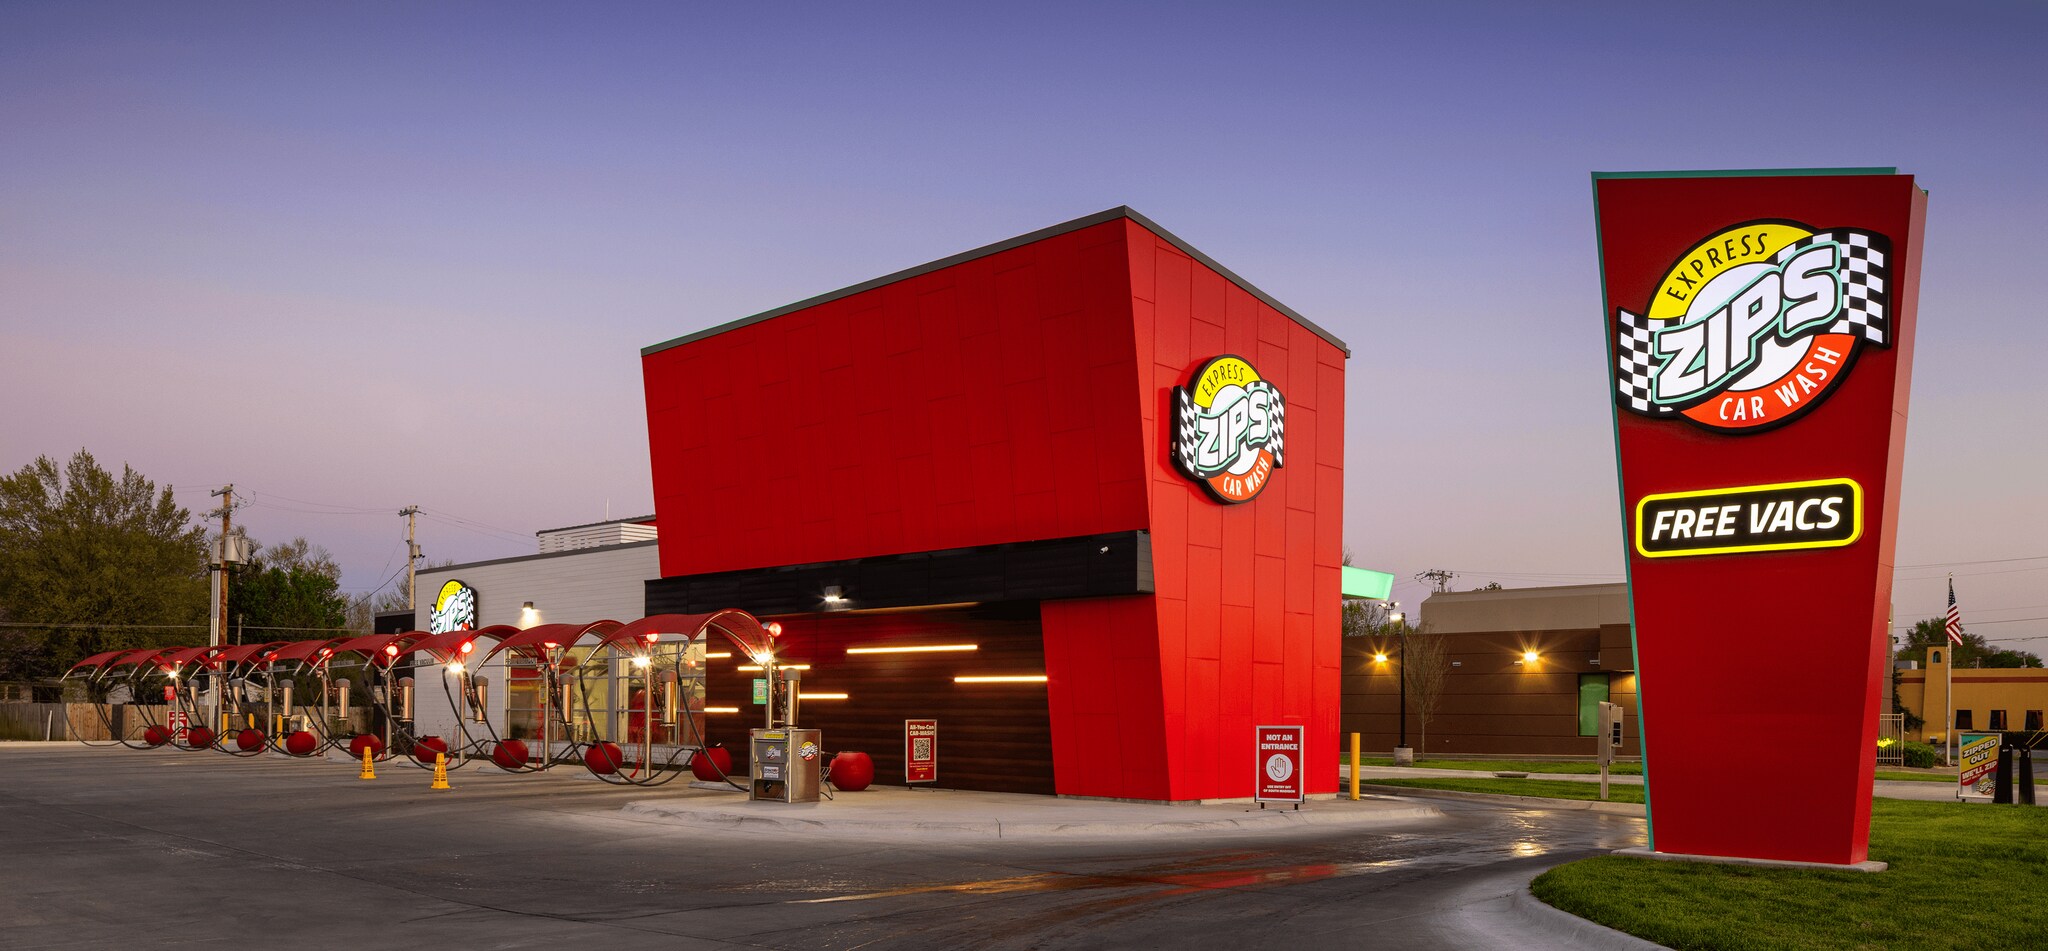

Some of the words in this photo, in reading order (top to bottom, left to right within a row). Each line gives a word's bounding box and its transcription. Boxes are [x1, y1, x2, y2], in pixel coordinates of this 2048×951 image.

[1666, 232, 1768, 302] EXPRESS
[1653, 242, 1841, 402] ZIPS
[1202, 363, 1245, 397] EXPRESS
[1719, 396, 1765, 421] CAR
[1775, 346, 1841, 407] WASH
[1196, 388, 1270, 469] ZIPS
[1223, 476, 1242, 496] CAR
[1245, 456, 1269, 493] WASH
[1651, 505, 1741, 541] FREE
[1749, 496, 1843, 534] VACS
[436, 591, 467, 634] ZIPS
[1962, 767, 1983, 779] WE'LL
[1985, 760, 1998, 771] ZIP
[1963, 739, 1996, 759] ZIPPED
[1970, 750, 1990, 765] OUT
[1979, 781, 1995, 793] ZIPS
